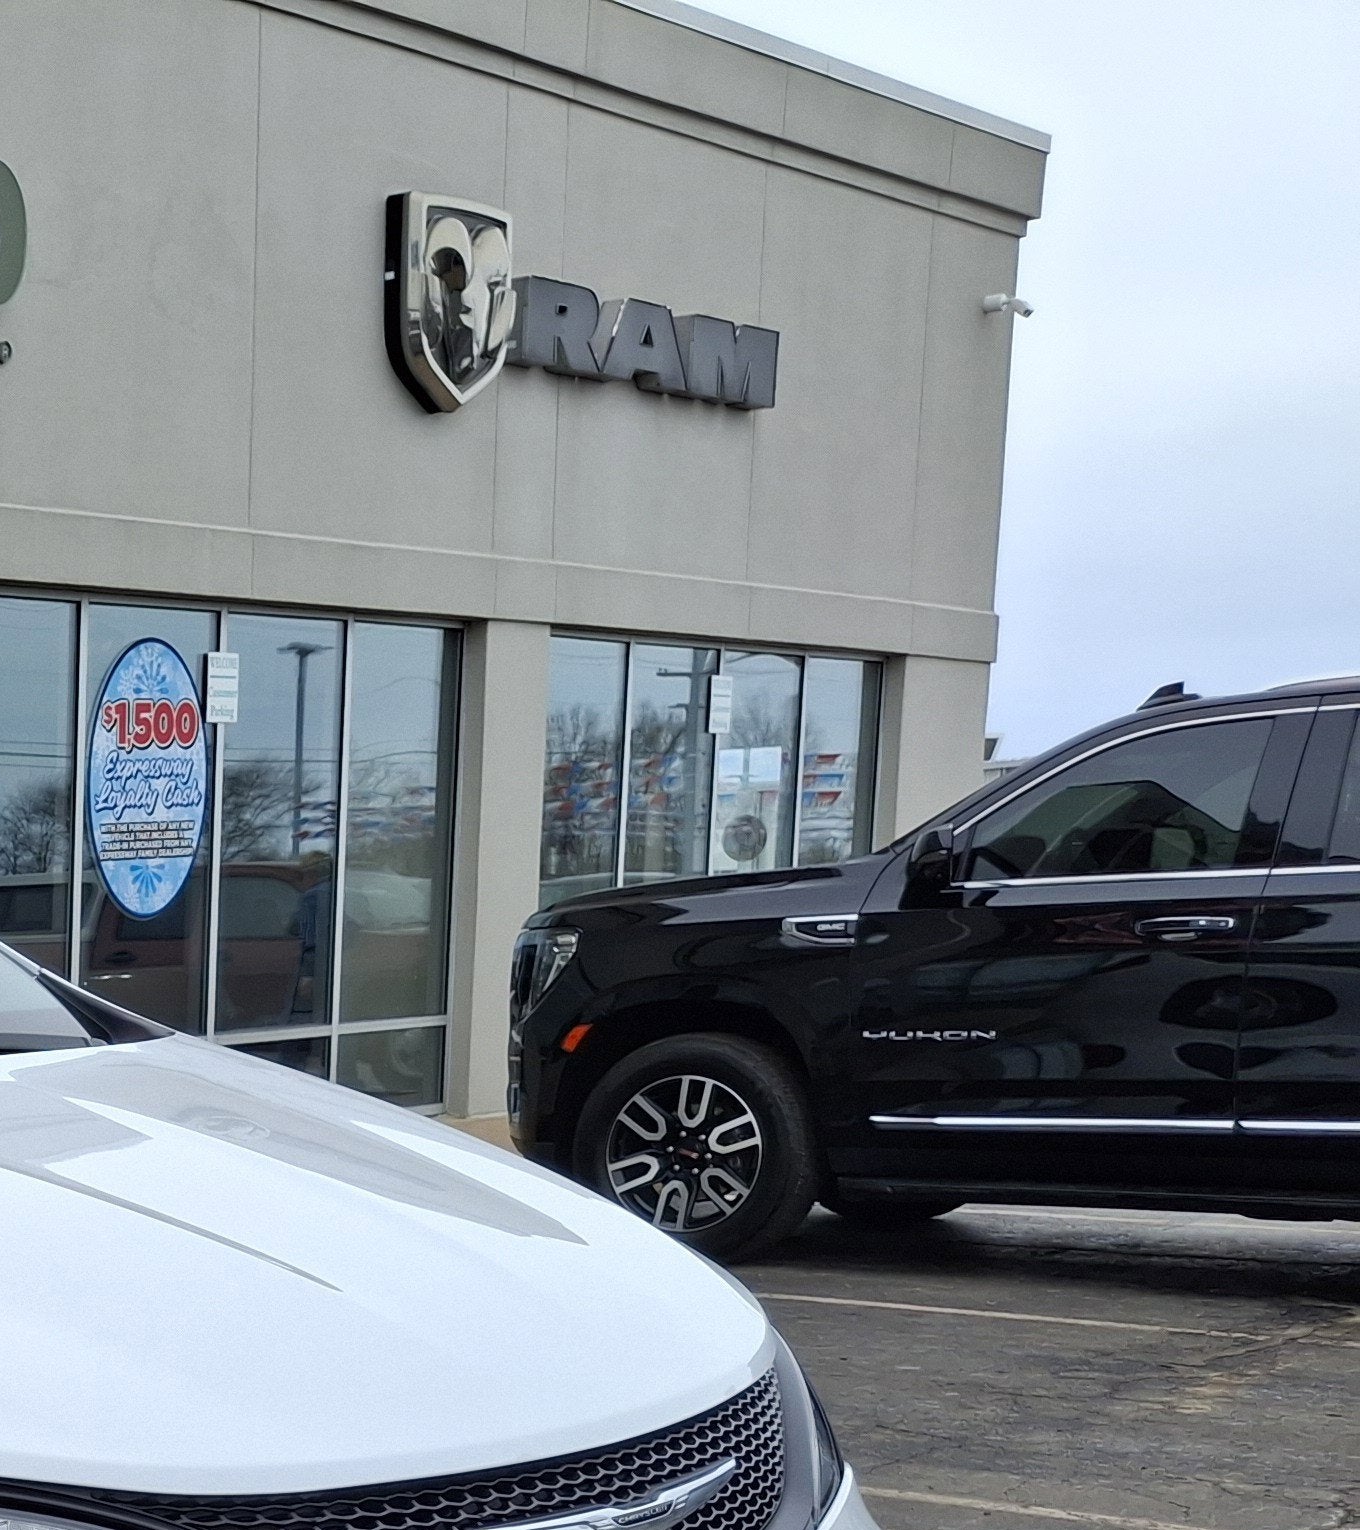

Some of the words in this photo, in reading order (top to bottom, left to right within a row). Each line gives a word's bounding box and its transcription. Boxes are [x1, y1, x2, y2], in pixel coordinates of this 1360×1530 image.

[507, 275, 780, 411] RAM
[102, 698, 199, 754] $1,500
[103, 750, 194, 789] Expressway
[94, 779, 159, 820] Loyalty
[162, 778, 202, 809] Cash
[129, 822, 158, 831] PURCHASE
[159, 821, 168, 831] OF
[168, 821, 180, 830] ANY
[180, 820, 195, 829] NEW
[136, 831, 150, 840] THAT
[129, 840, 162, 850] PURCHASED
[164, 839, 179, 848] FROM
[180, 838, 193, 848] ANY
[816, 922, 846, 931] GMC
[861, 1029, 998, 1042] YUKON
[618, 1505, 668, 1524] CHRYSLER
